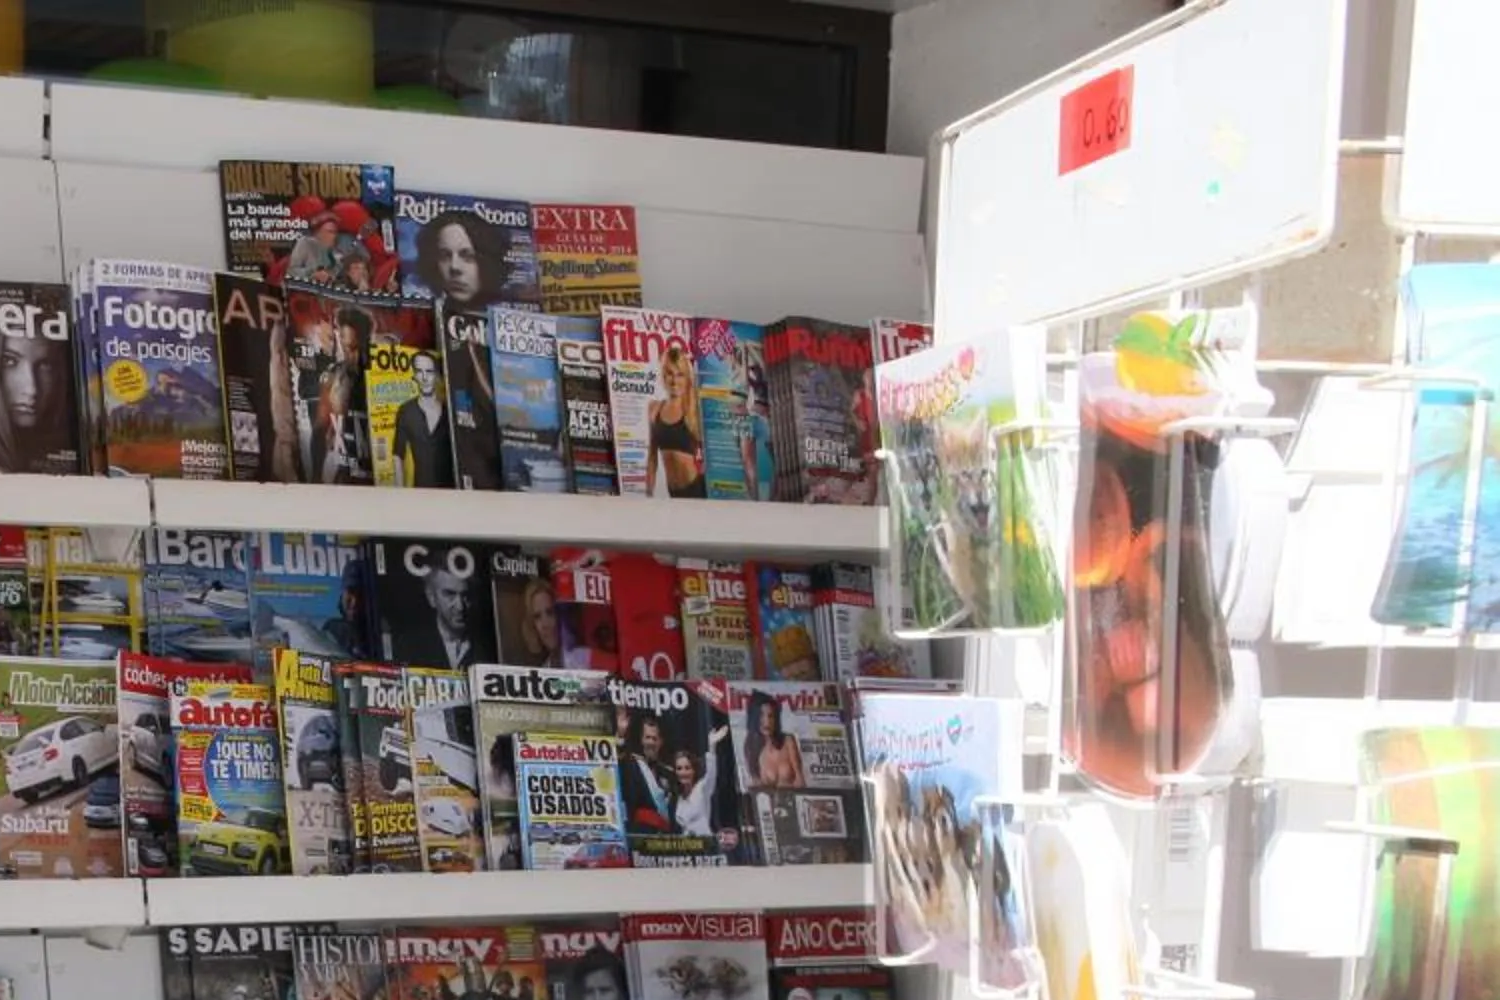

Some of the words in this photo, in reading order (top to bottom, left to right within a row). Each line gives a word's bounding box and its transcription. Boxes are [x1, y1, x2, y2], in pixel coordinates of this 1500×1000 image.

[299, 166, 360, 199] STONES
[228, 204, 243, 215] La
[248, 204, 290, 217] banda
[533, 208, 629, 231] EXTRA
[230, 231, 251, 240] del
[261, 219, 308, 231] grande
[113, 263, 164, 279] FORMAS
[106, 339, 139, 357] de
[136, 342, 212, 366] paisajes
[611, 382, 656, 396] desnudo
[493, 553, 539, 577] Capital
[124, 666, 167, 688] coches
[484, 670, 565, 700] auto
[608, 681, 689, 716] tiempo
[254, 741, 274, 760] NO
[211, 760, 230, 779] TE
[528, 776, 596, 795] COCHES
[530, 795, 607, 816] USADOS
[1, 812, 69, 834] Subaru
[683, 911, 760, 938] Visual
[780, 918, 823, 951] AÑO
